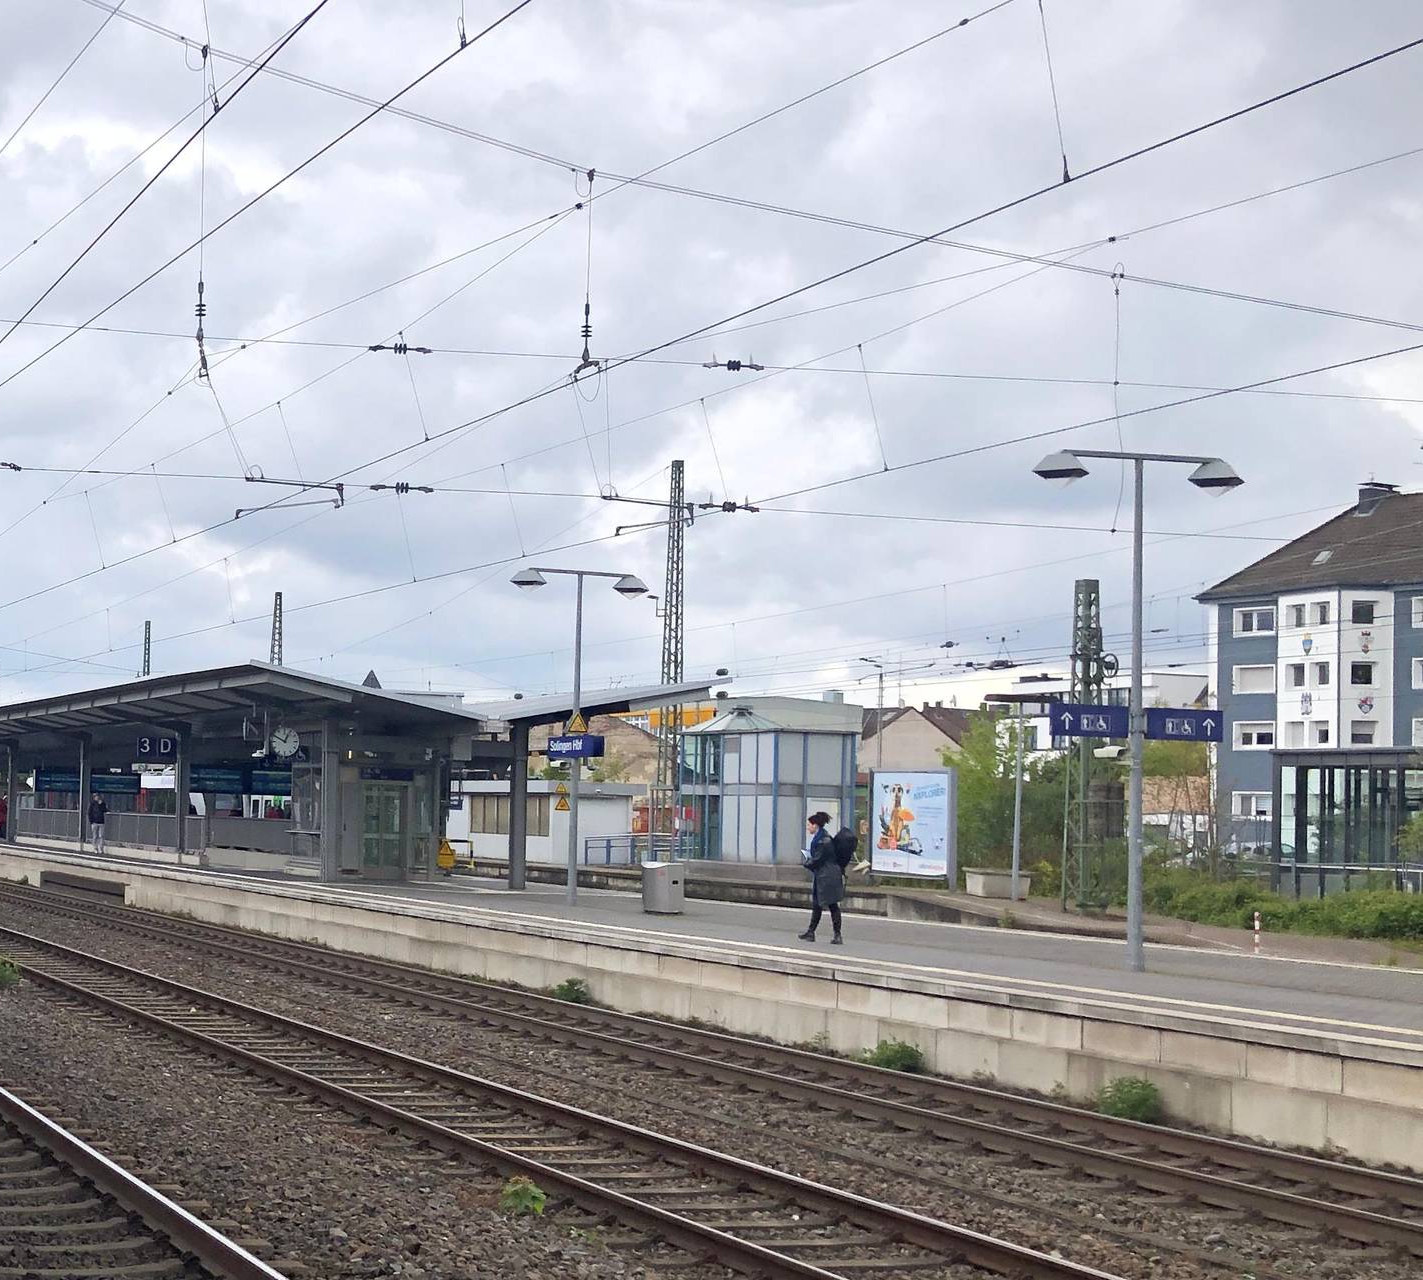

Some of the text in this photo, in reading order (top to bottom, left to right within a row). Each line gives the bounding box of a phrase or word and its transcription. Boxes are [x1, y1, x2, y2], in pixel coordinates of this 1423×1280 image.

[140, 737, 171, 753] 3 D
[550, 739, 583, 753] Solingen Hbf
